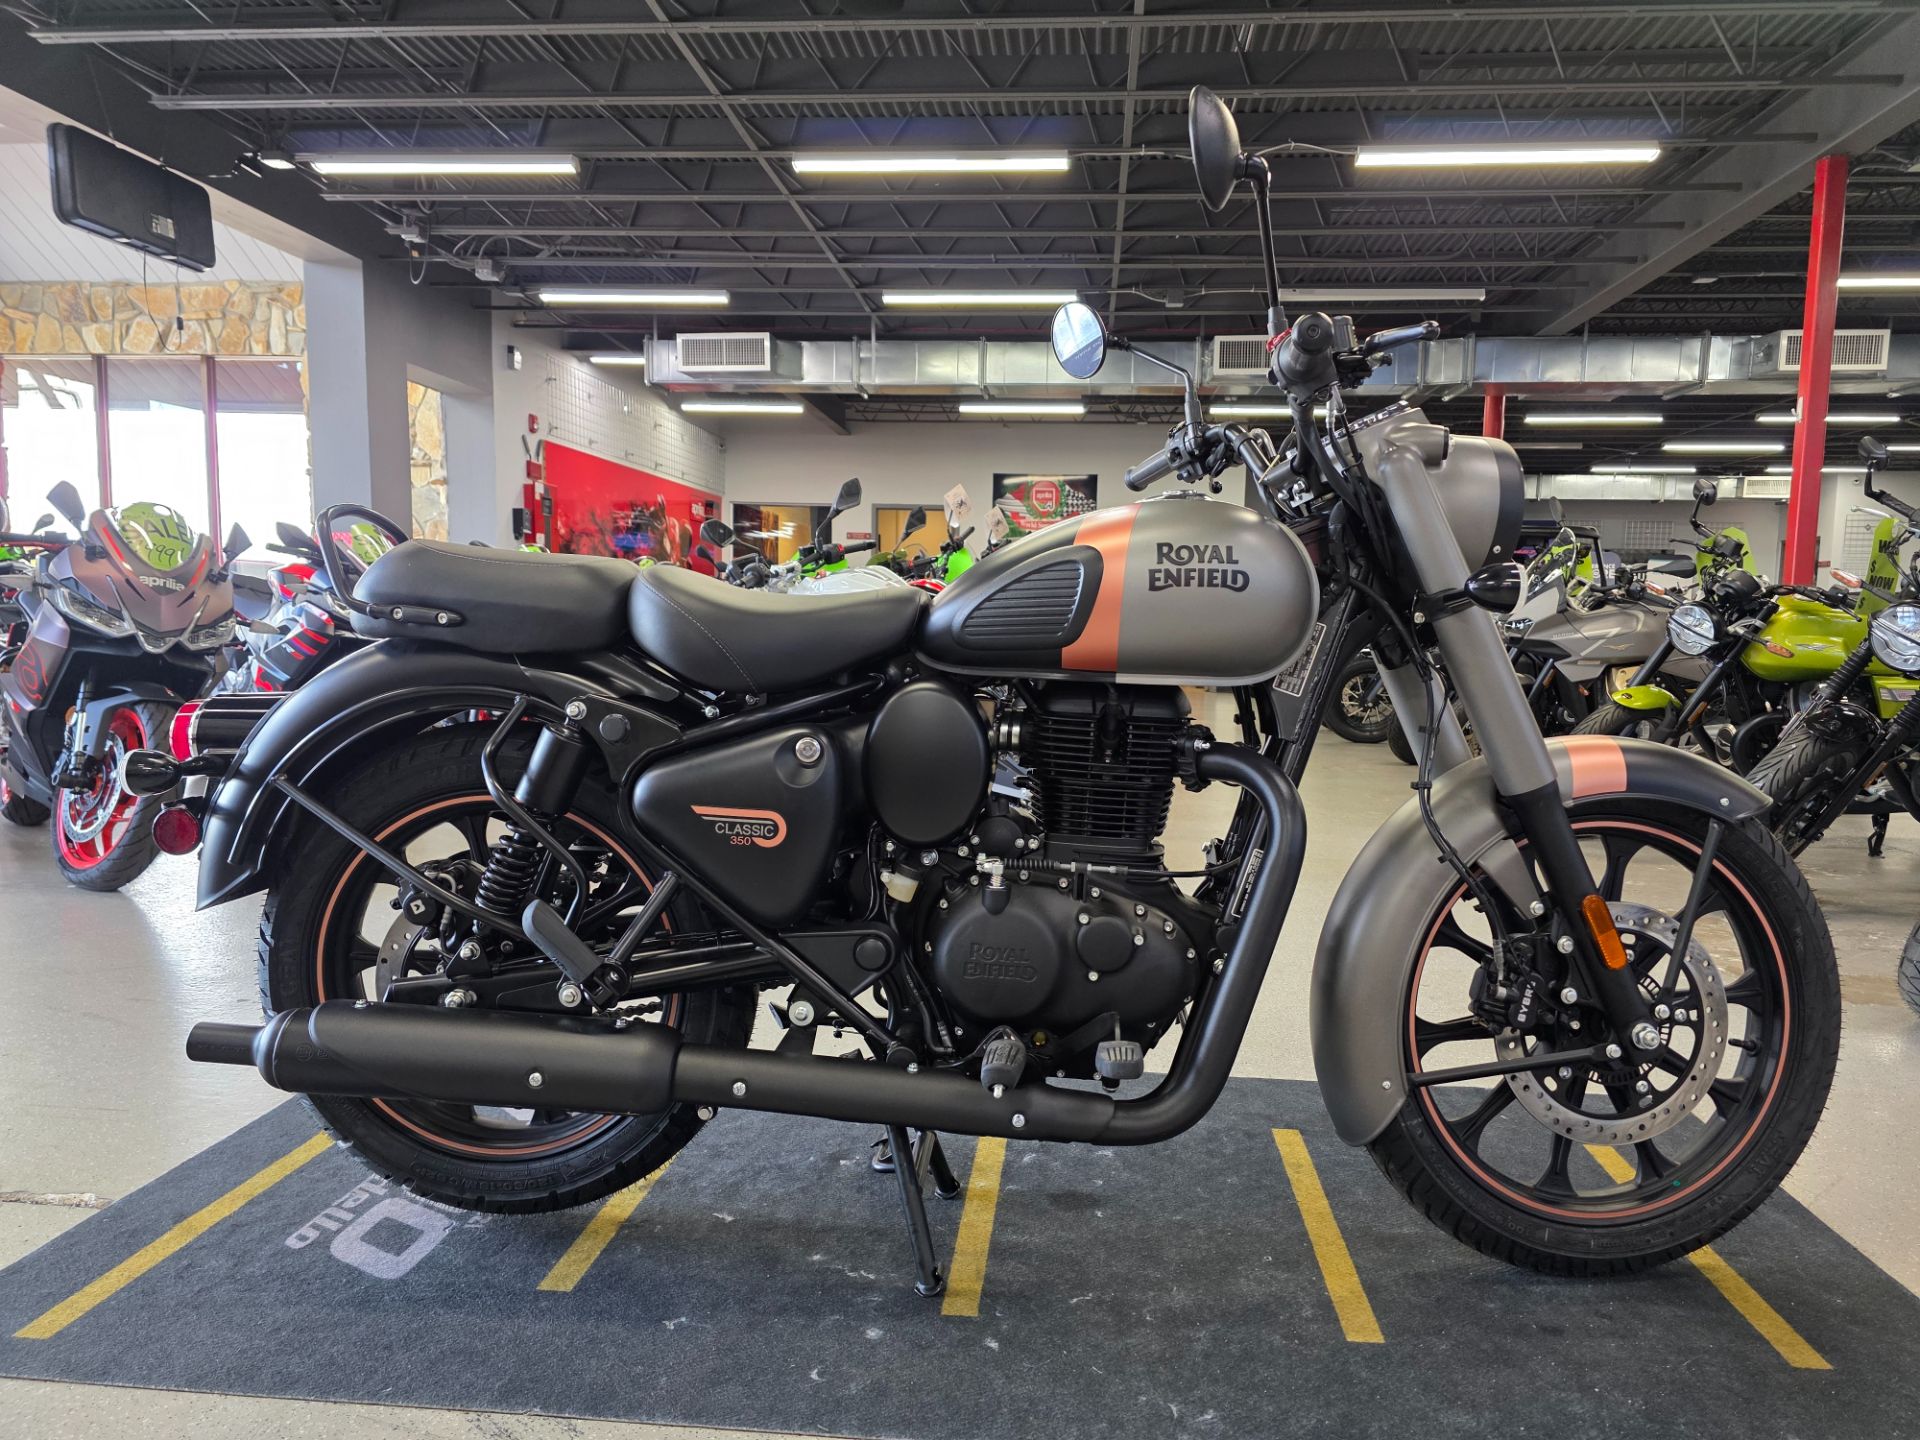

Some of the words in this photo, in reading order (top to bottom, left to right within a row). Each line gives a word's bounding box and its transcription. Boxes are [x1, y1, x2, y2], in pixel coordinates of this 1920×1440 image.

[1156, 542, 1239, 566] ROYAL
[139, 575, 185, 592] aprilia
[1148, 567, 1250, 592] ENFIELD
[1869, 575, 1895, 590] NOW
[715, 822, 775, 837] CLASSIC
[730, 835, 751, 846] 350
